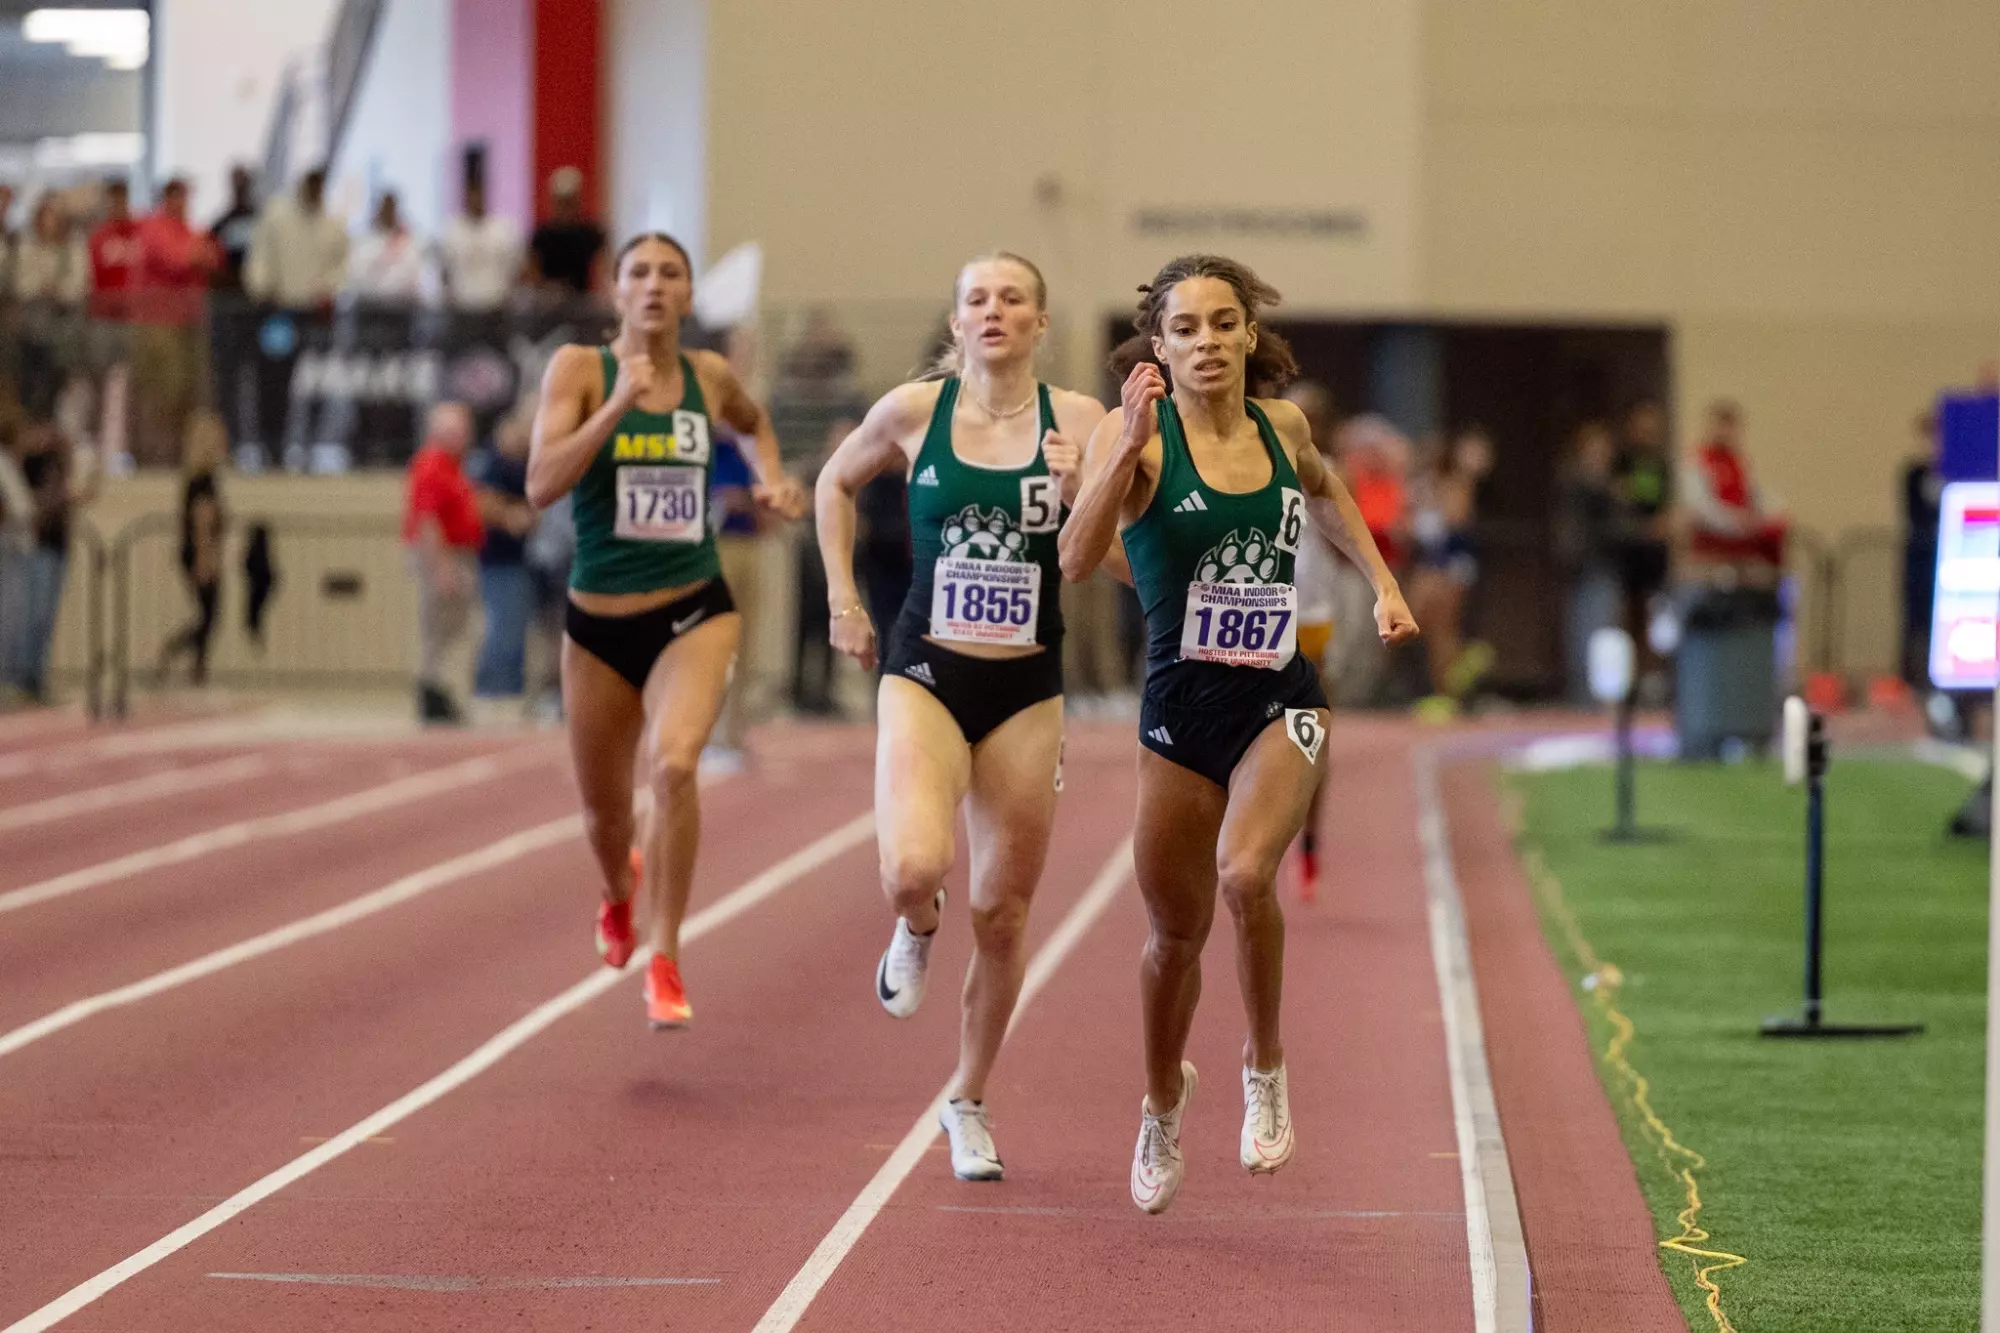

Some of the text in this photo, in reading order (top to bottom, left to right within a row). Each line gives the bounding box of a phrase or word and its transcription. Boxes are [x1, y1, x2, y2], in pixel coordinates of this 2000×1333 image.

[679, 417, 697, 454] 3
[627, 488, 697, 521] 1730
[1026, 482, 1049, 527] 5
[1284, 497, 1301, 547] 6
[942, 582, 1033, 625] 1855
[1200, 594, 1287, 607] CHAMPIONSHIPS
[1211, 585, 1278, 597] MIAA INDOOR
[1195, 607, 1292, 650] 1867
[1198, 648, 1227, 657] HOSTED
[1240, 651, 1279, 659] PITTSBURG
[1293, 711, 1316, 748] 6
